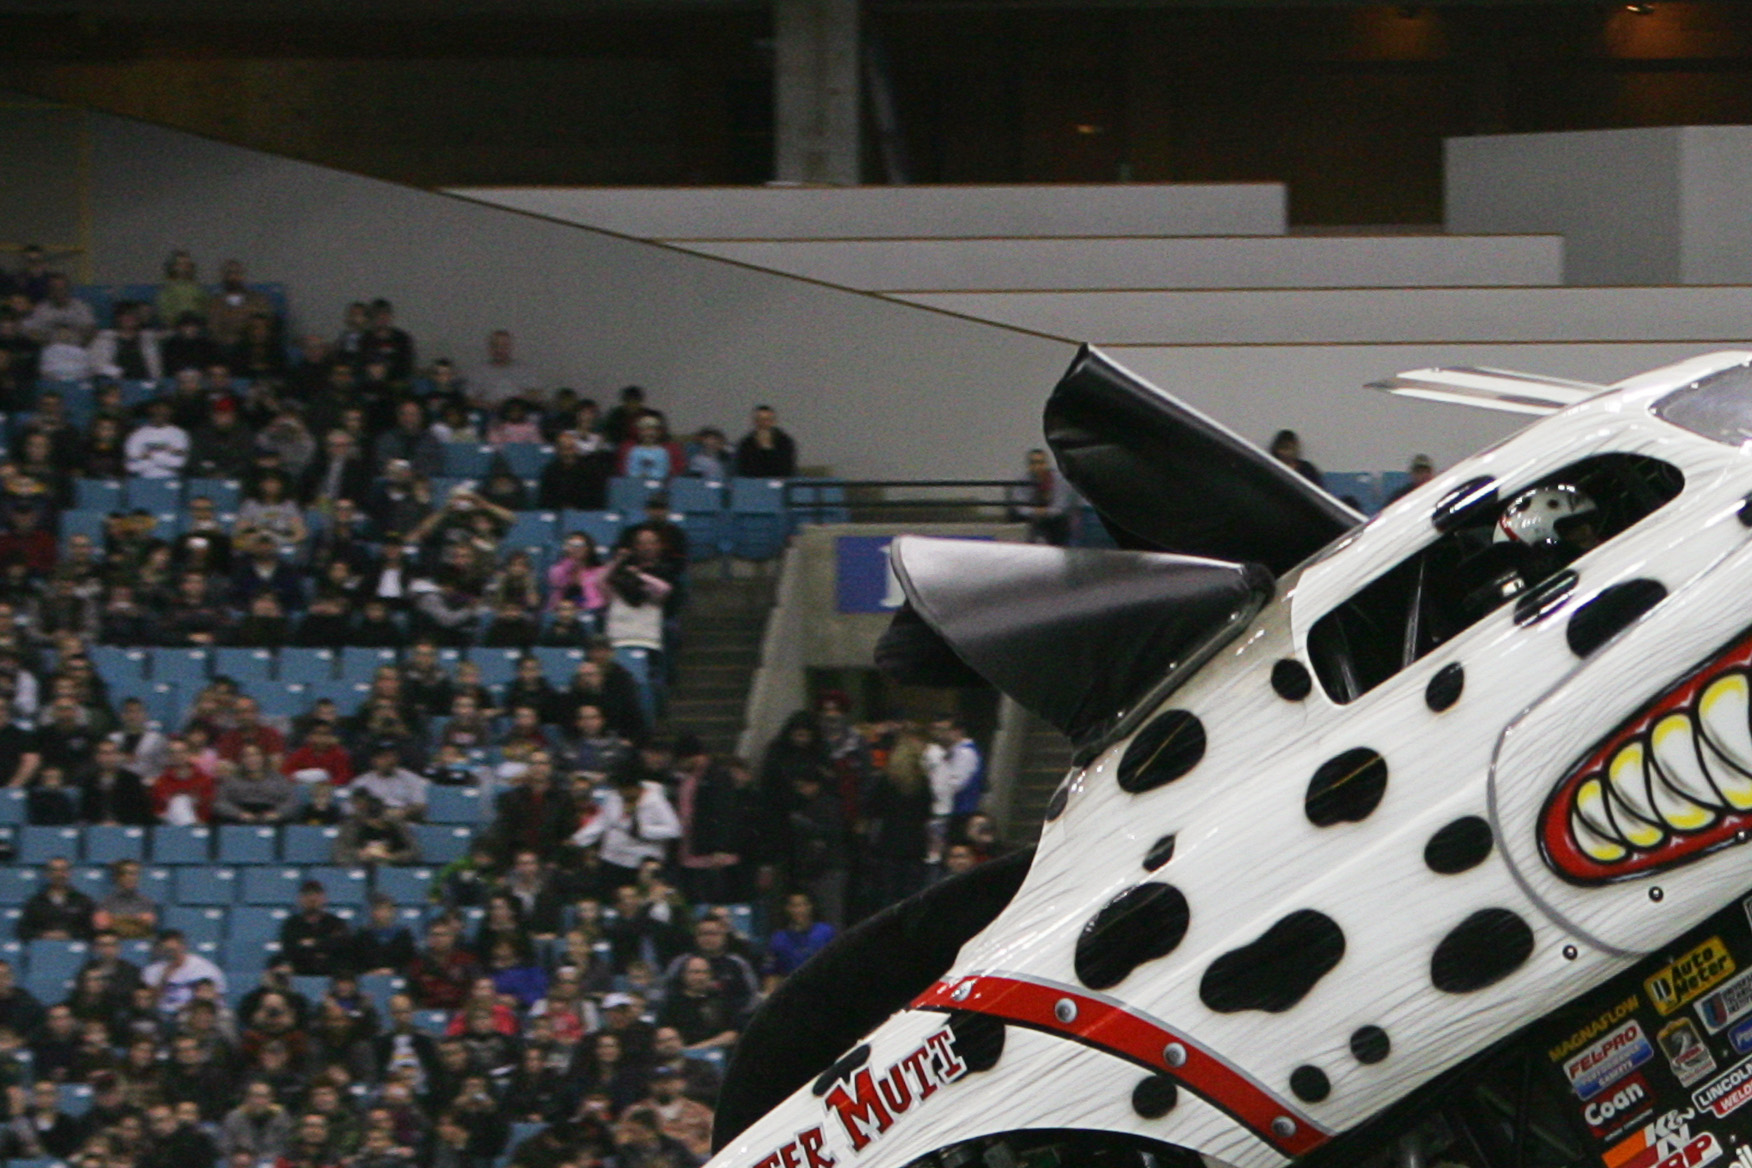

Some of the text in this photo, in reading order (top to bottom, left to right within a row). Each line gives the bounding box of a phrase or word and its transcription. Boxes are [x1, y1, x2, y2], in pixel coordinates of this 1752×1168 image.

[1671, 946, 1714, 984] Auto
[1674, 955, 1727, 1003] Meter
[1548, 994, 1640, 1062] MAGNAFLOW
[823, 1024, 968, 1157] MUTT
[1583, 1082, 1645, 1127] Coan
